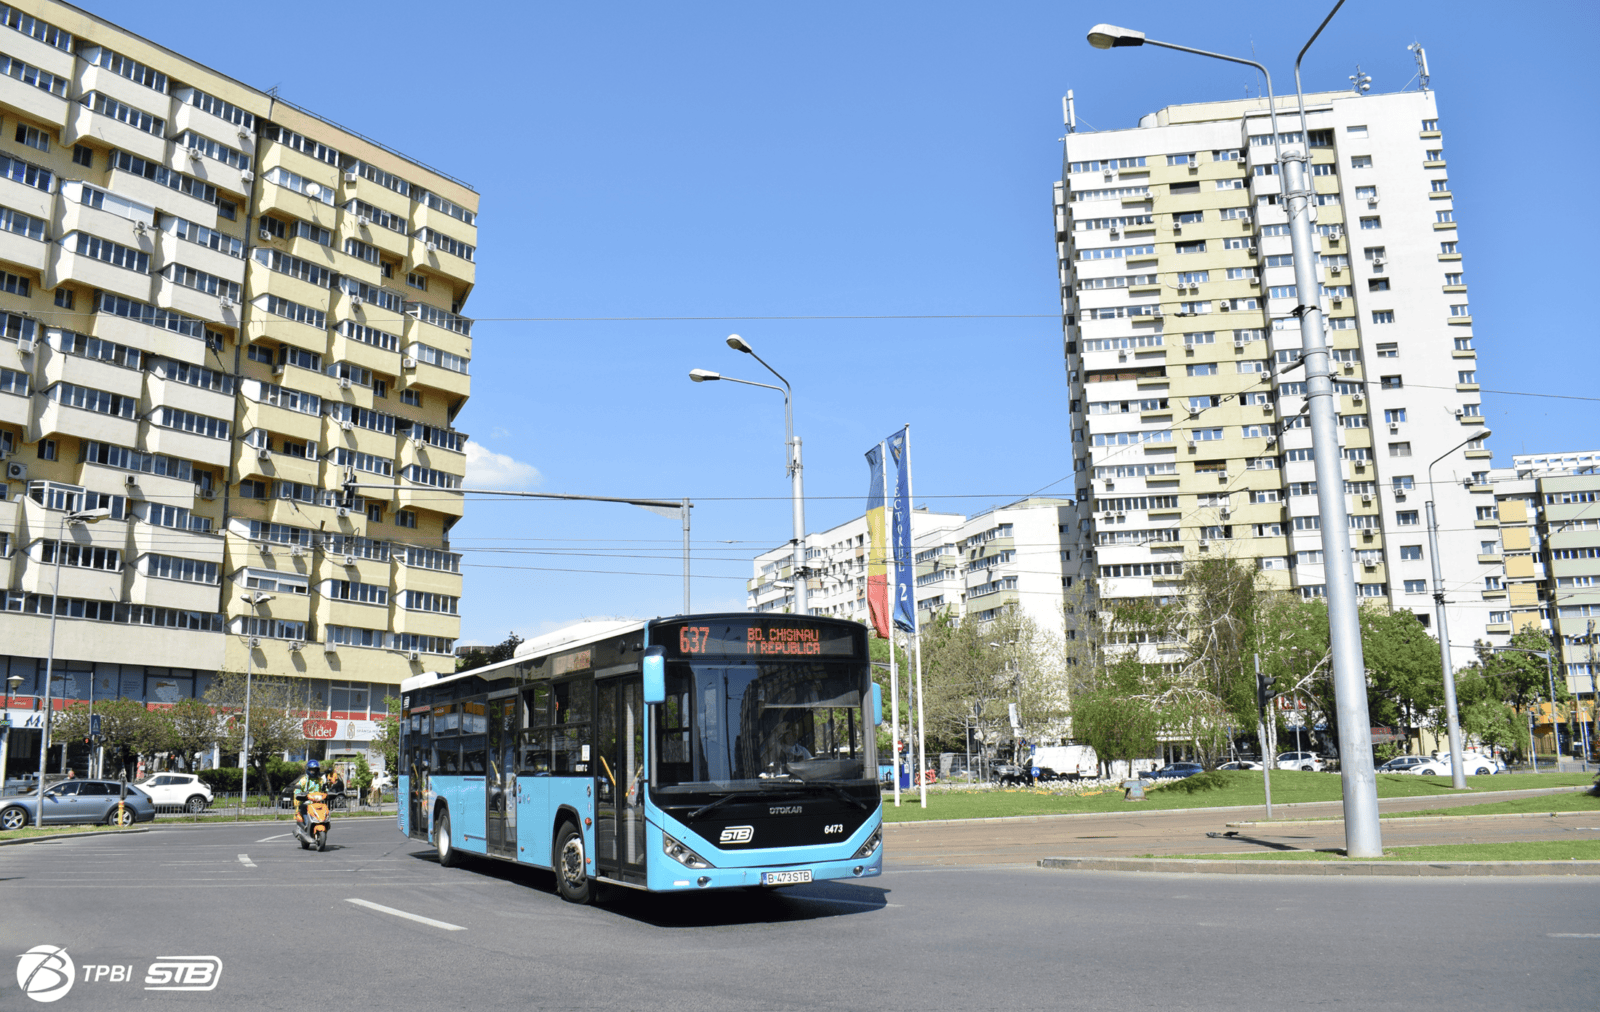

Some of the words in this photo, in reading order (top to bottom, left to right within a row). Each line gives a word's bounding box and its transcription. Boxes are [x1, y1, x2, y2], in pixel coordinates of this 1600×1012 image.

[899, 582, 908, 601] 2
[679, 626, 710, 654] 637
[747, 627, 766, 641] BD.
[769, 628, 819, 642] CHISINAU
[747, 641, 757, 654] M
[760, 641, 821, 655] REPUBLICA
[769, 805, 803, 815] OTOKAR
[719, 827, 752, 842] STB
[824, 823, 844, 835] 6473
